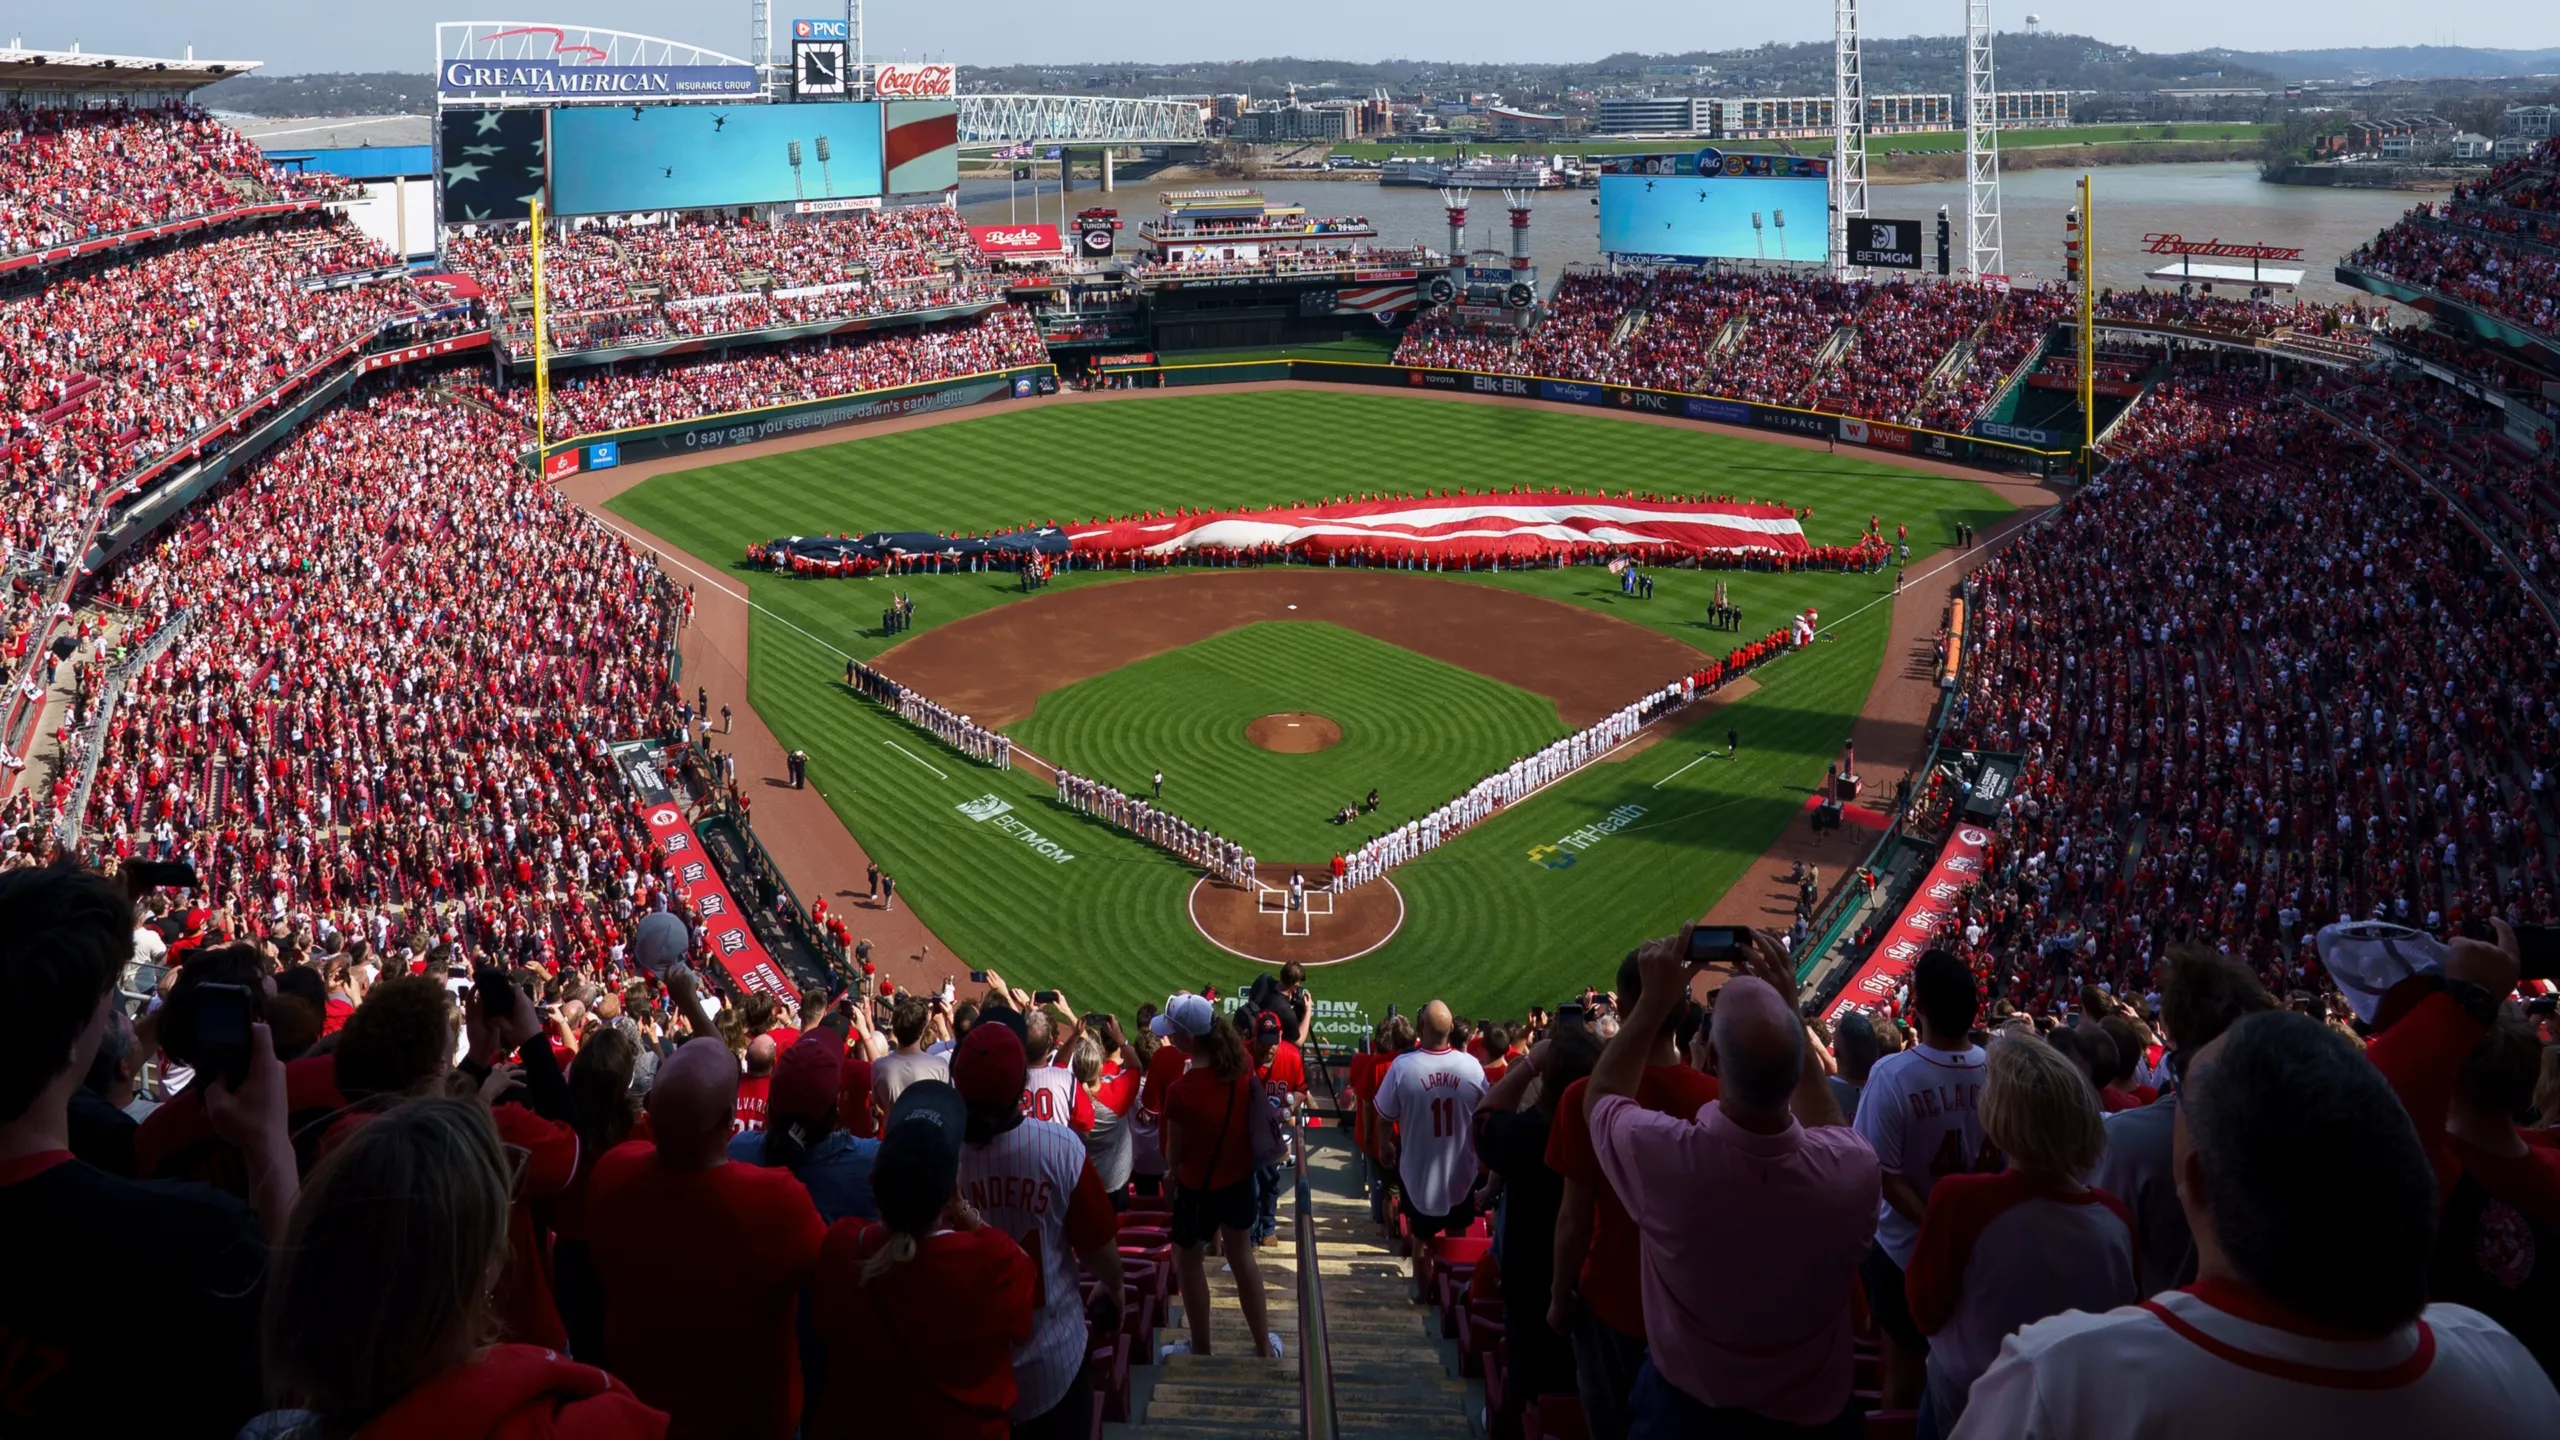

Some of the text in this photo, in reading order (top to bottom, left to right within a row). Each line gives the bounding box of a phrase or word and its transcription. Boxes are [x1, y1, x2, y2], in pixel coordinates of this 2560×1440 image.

[813, 22, 845, 36] PNC
[446, 63, 545, 87] GREAT
[675, 81, 722, 91] INSURANCE
[724, 81, 752, 91] GROUP
[1700, 156, 1721, 168] P&G
[1726, 160, 1742, 170] Tide
[813, 199, 875, 210] TOYOTA TUNDRA
[1082, 222, 1112, 230] TUNDRA
[1337, 223, 1368, 232] TriHealth
[985, 229, 1042, 246] Reds
[2144, 233, 2301, 259] Budweiser
[1613, 253, 1650, 265] BEACON
[1856, 250, 1913, 265] BETMGM
[1483, 269, 1504, 278] PNC
[1425, 375, 1455, 384] TOYOTA
[1636, 393, 1667, 409] PNC
[685, 389, 964, 446] O say can you see by the dawn's early light
[1764, 414, 1823, 431] MEDPACE
[1873, 427, 1907, 443] Wyler
[1982, 422, 2047, 443] GEICO
[547, 464, 579, 481] Budweiser
[1557, 804, 1649, 850] TriHealth
[992, 814, 1075, 865] BETMGM
[683, 862, 702, 881] 1961
[1929, 882, 1958, 900] 1976
[700, 894, 721, 915] 1970
[1910, 910, 1939, 930] 1975
[721, 930, 743, 953] 1972
[755, 962, 786, 994] NATIONAL
[1862, 974, 1896, 994] 1919
[1316, 1000, 1359, 1018] DAY
[1312, 1021, 1374, 1034] Adobe
[1420, 1071, 1461, 1091] LARKIN
[1019, 1087, 1053, 1121] 20
[1430, 1096, 1454, 1138] 11
[968, 1176, 1051, 1214] NDERS
